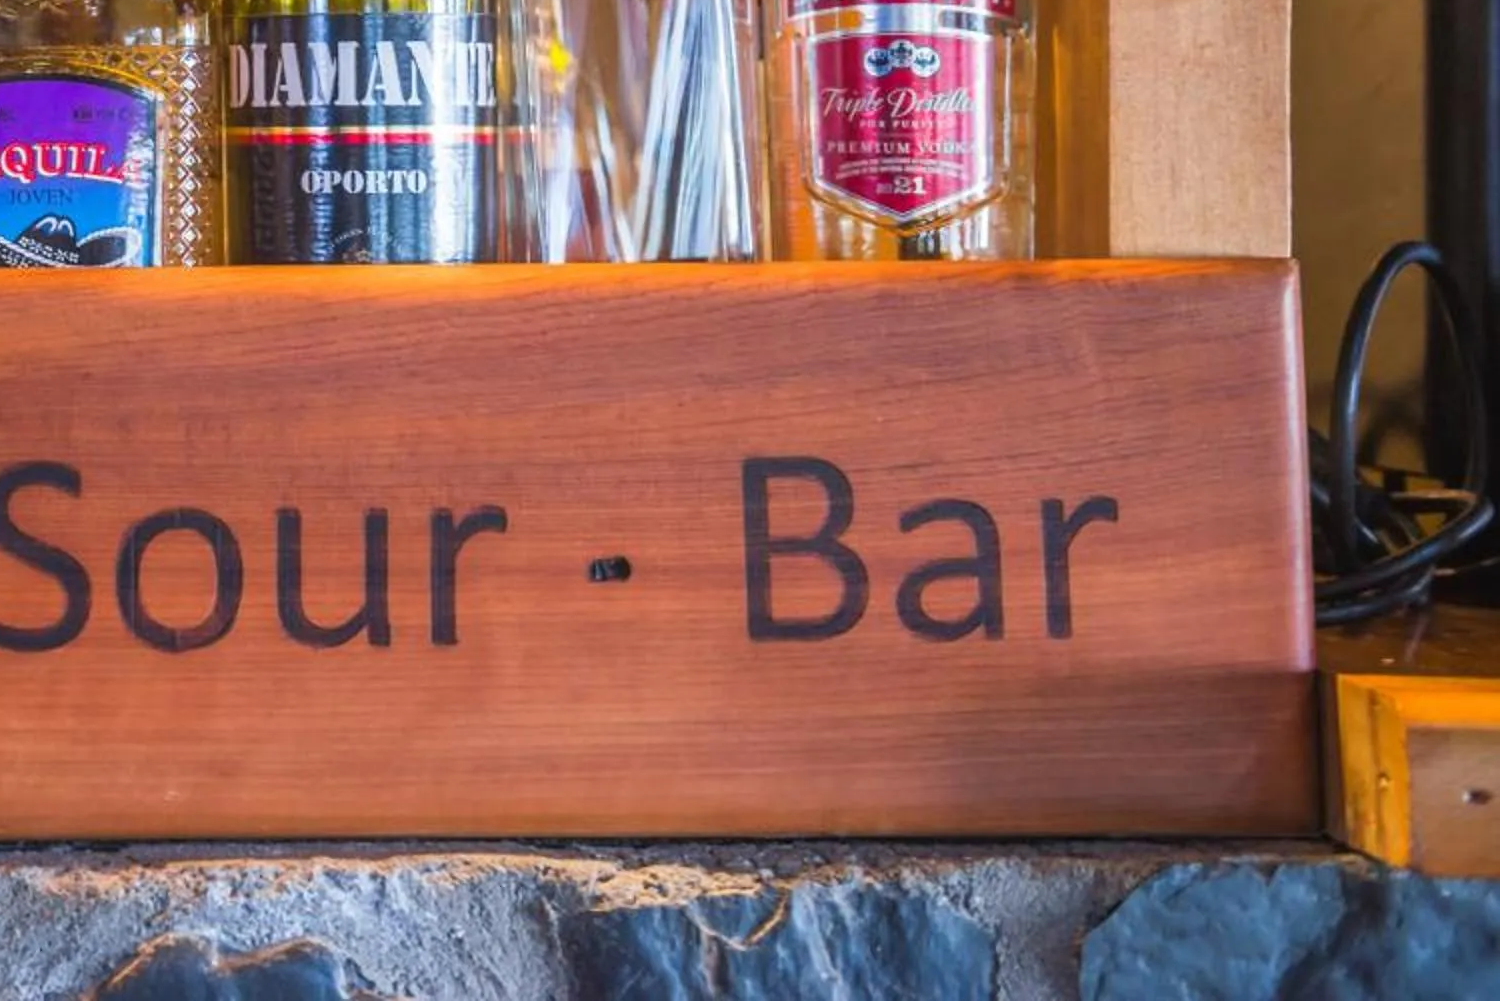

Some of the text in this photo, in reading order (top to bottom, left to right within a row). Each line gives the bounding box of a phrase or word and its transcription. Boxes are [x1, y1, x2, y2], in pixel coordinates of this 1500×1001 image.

[822, 87, 976, 122] Triple Distille
[827, 141, 974, 154] PREMIUM VODK
[300, 169, 428, 195] OPORTO
[894, 176, 927, 195] 21
[9, 188, 74, 206] JOVEN
[741, 455, 1119, 641] Bar
